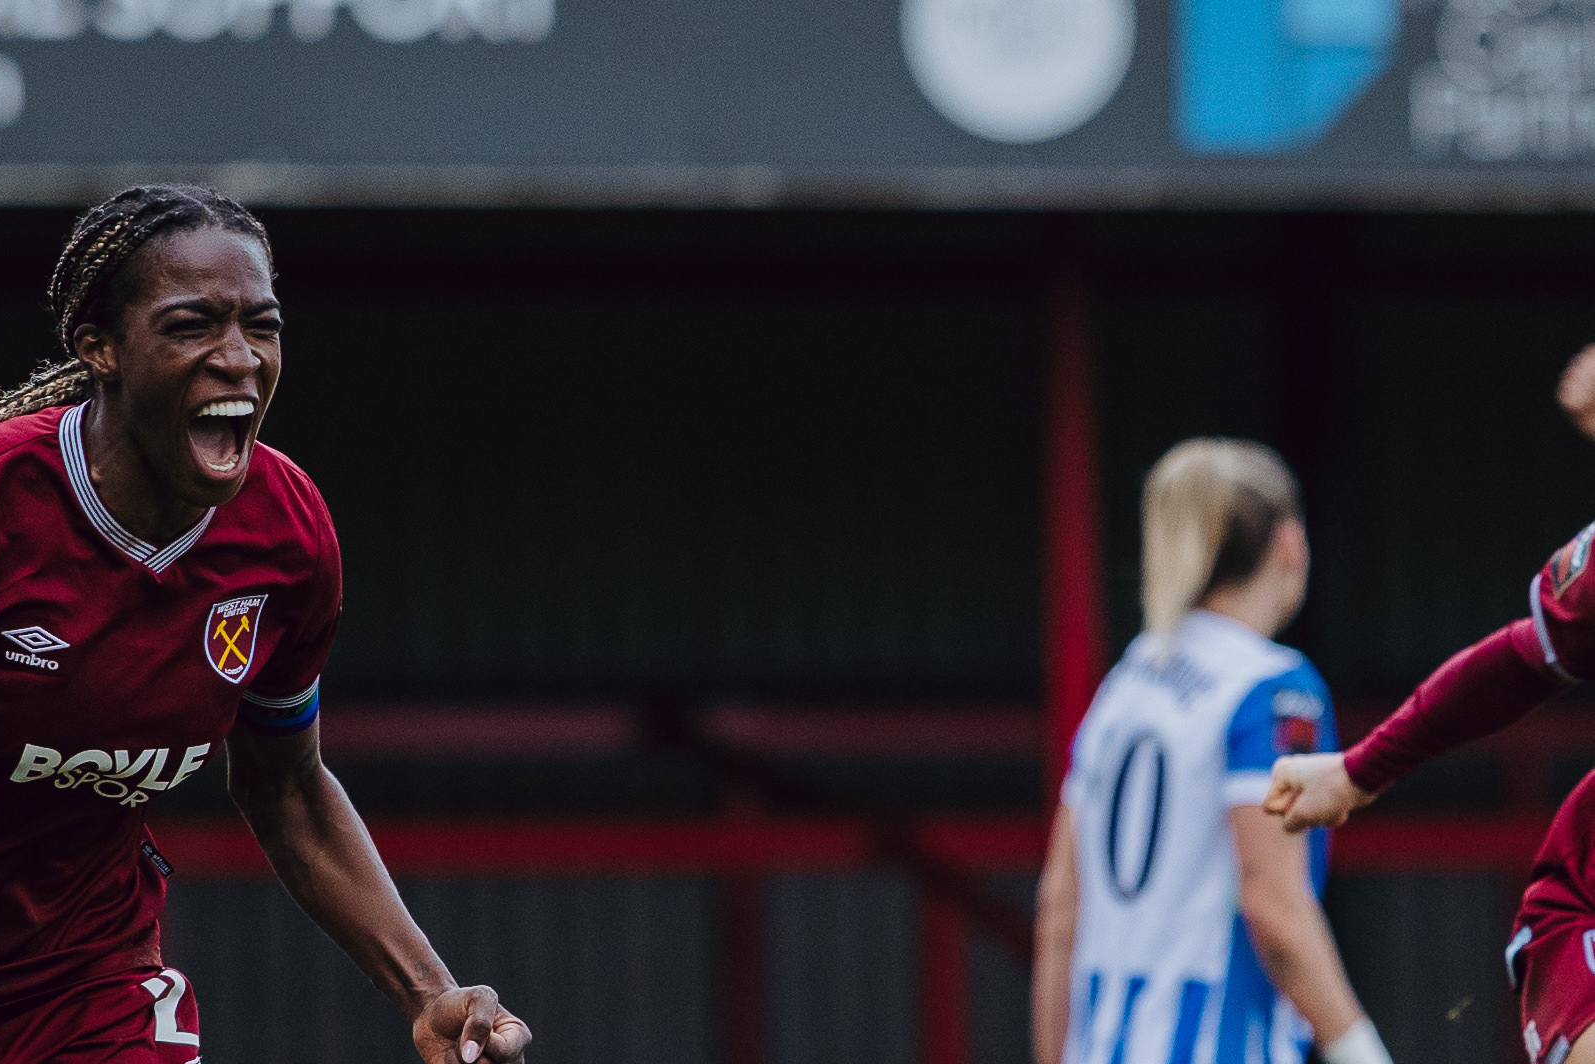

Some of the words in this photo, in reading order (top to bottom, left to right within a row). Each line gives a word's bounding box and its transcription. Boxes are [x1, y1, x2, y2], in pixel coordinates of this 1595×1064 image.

[217, 601, 241, 614] WEST
[240, 599, 261, 608] HAM
[223, 607, 250, 618] UNITED
[5, 650, 59, 671] umbro
[9, 743, 211, 791] BOYLE
